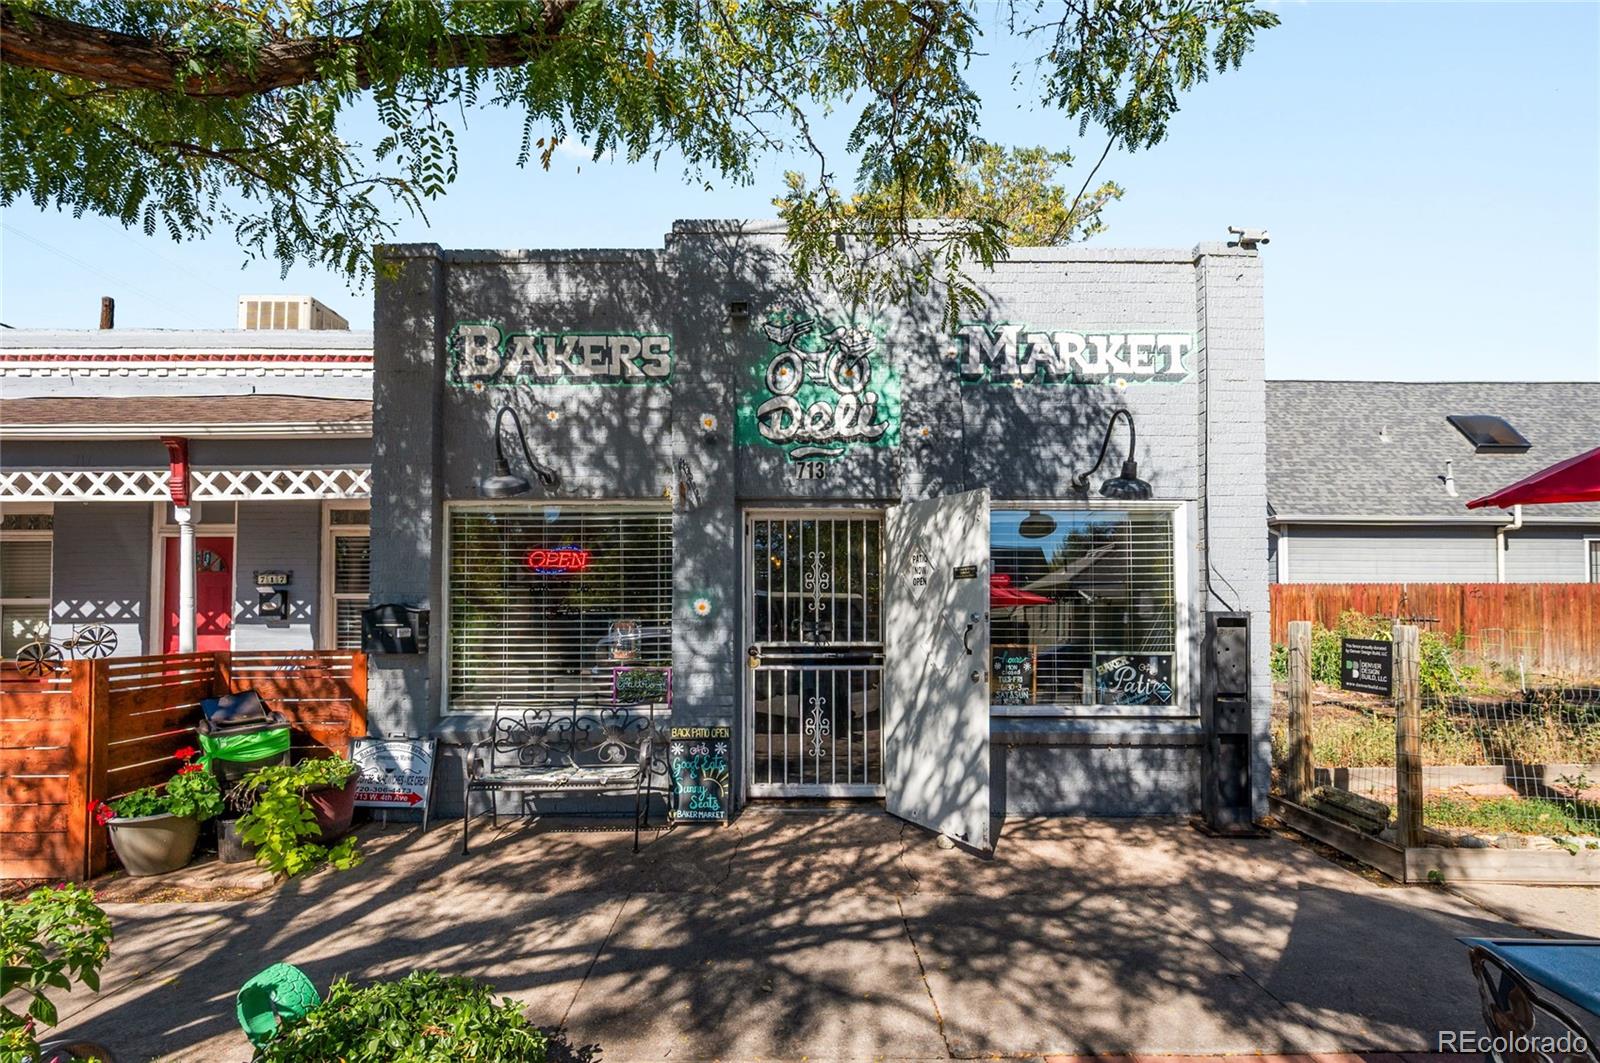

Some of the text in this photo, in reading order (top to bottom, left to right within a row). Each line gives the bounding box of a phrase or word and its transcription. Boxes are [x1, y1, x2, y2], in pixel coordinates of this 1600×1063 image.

[457, 324, 672, 381] BAKERS
[957, 324, 1193, 380] MARKET
[756, 393, 889, 443] Deli
[797, 461, 825, 479] 713
[528, 550, 589, 569] OPEN
[258, 575, 286, 584] 717
[912, 577, 927, 586] OPEN
[1096, 656, 1130, 676] BAKER
[1361, 662, 1382, 670] DENVER
[671, 727, 730, 738] BACK PATIO OPEN
[673, 755, 700, 777] Good
[674, 777, 708, 801] Sunny
[689, 794, 720, 811] Seats
[677, 810, 725, 819] BAKER MARKET
